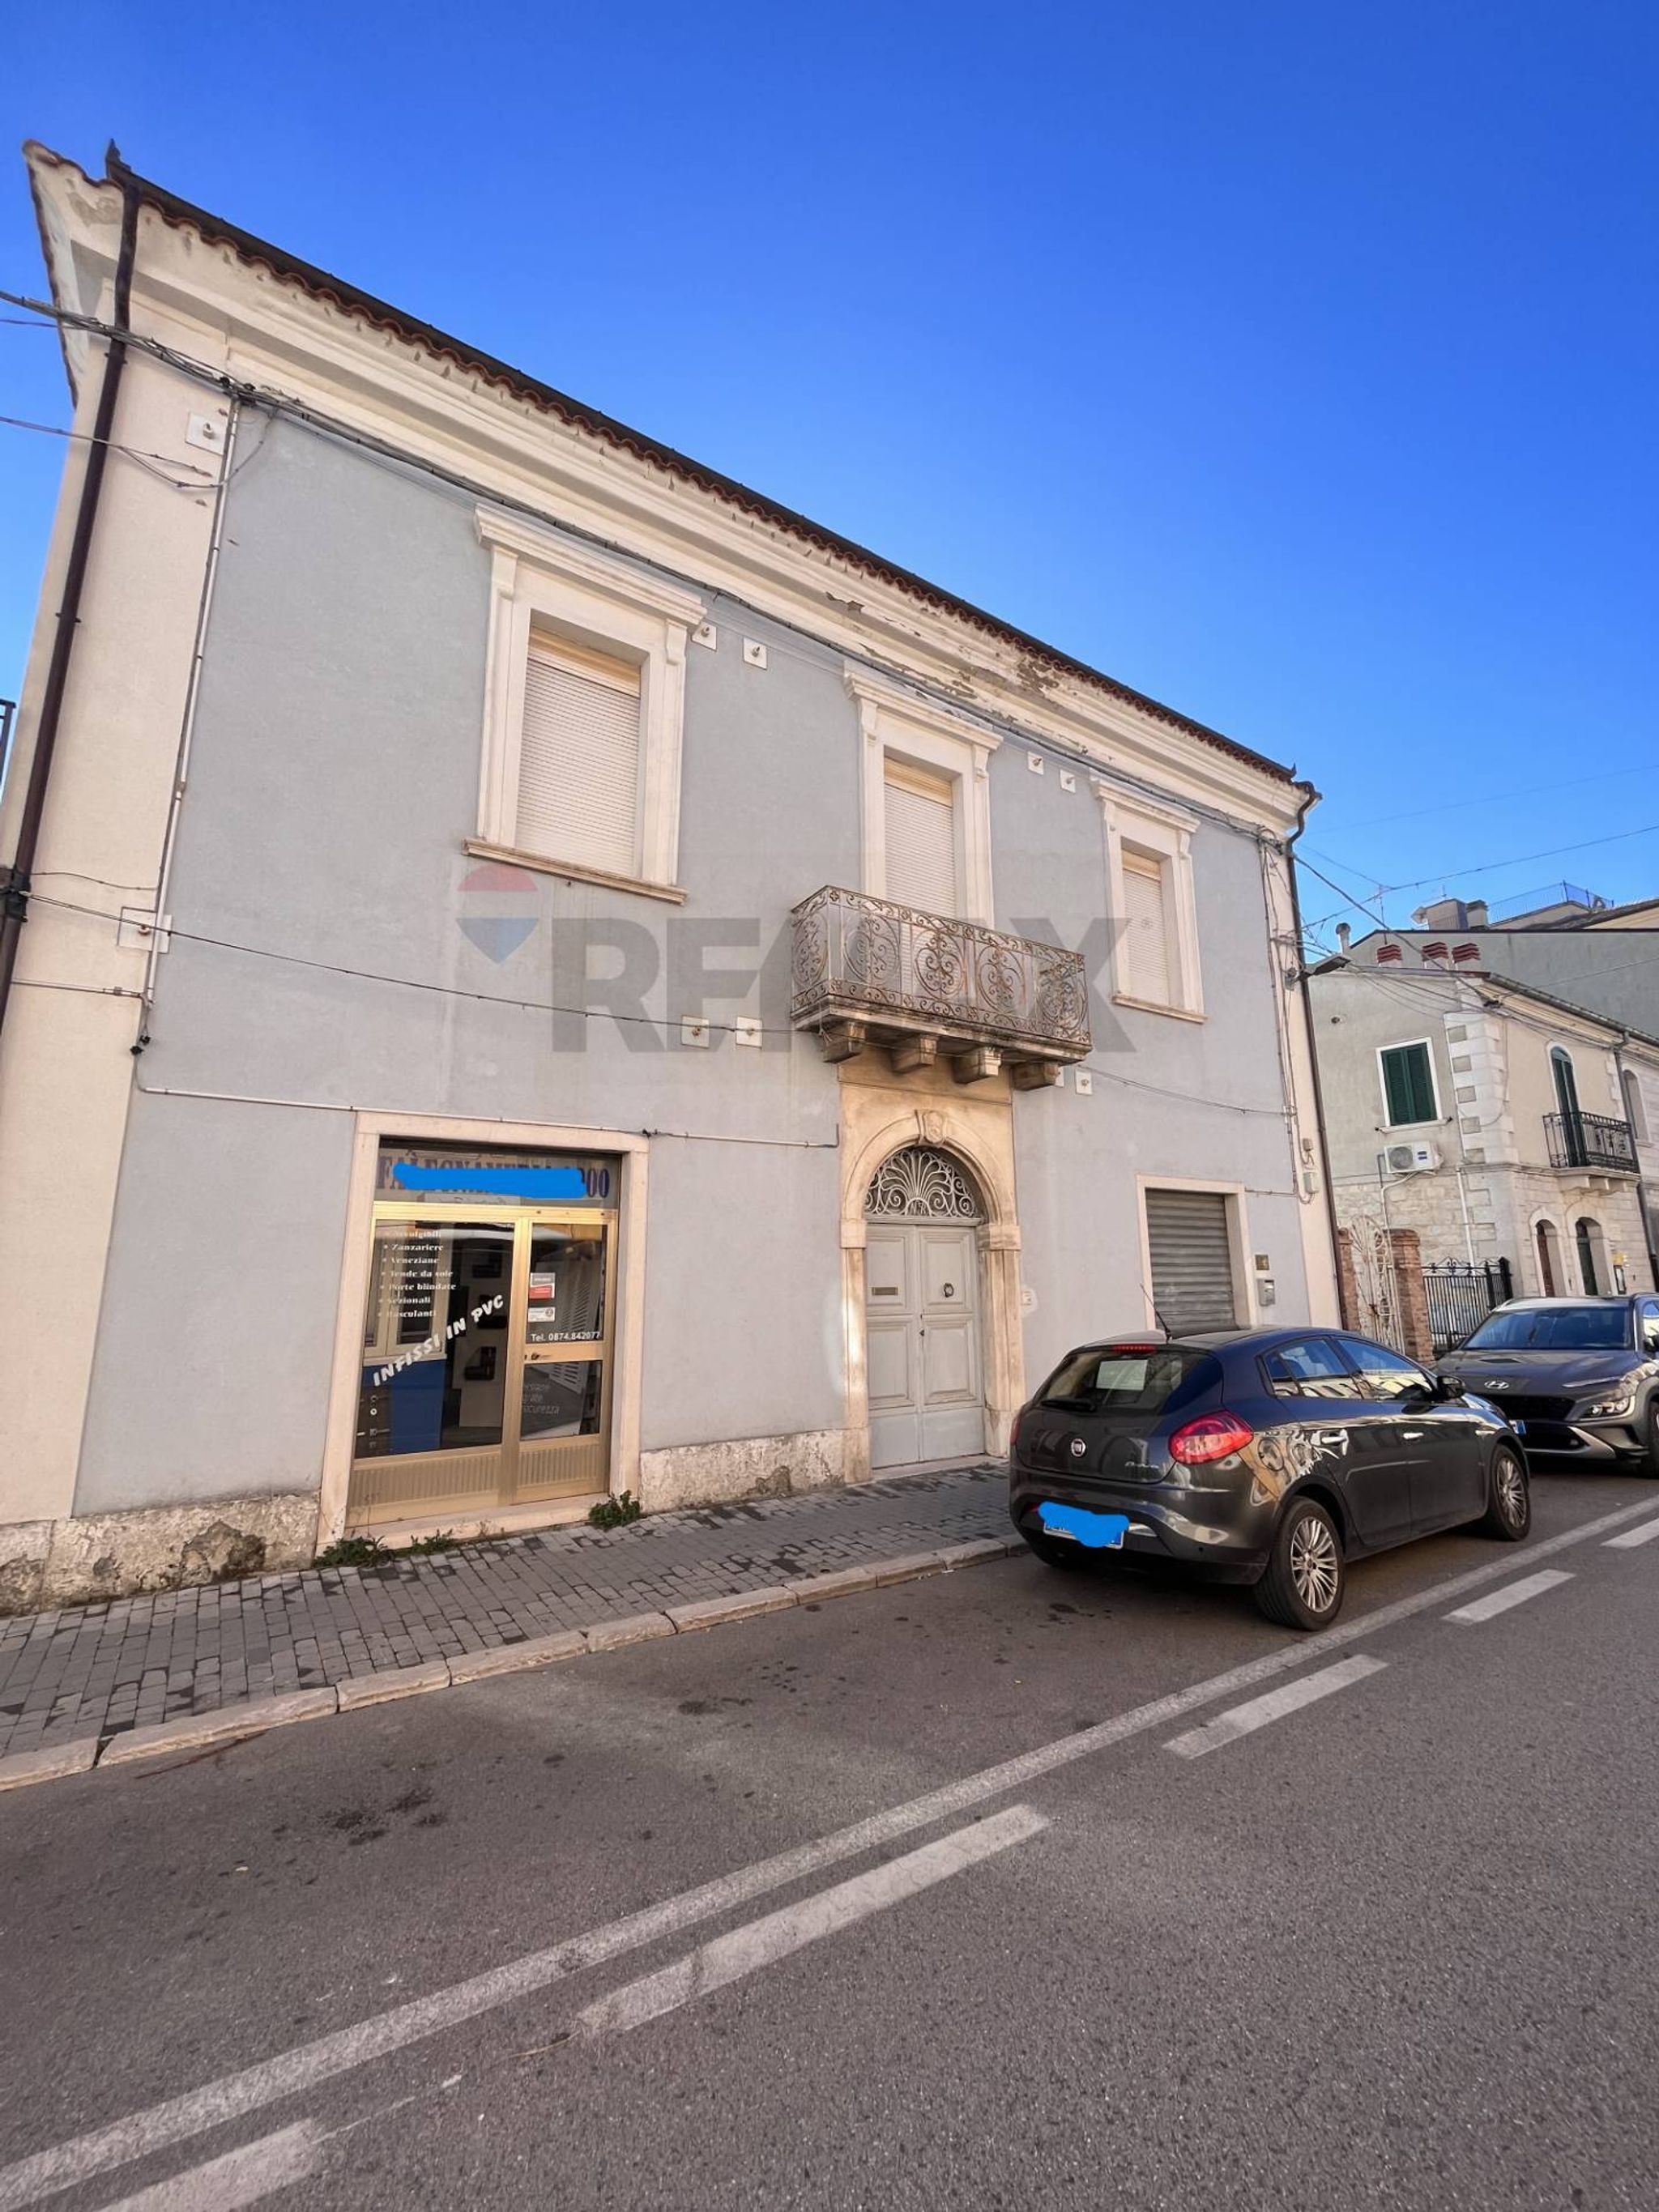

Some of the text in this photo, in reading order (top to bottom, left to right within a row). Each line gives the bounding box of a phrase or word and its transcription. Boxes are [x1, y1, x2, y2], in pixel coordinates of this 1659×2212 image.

[373, 1333, 441, 1387] INFISSI
[446, 1317, 467, 1340] IN
[471, 1294, 504, 1323] PVC
